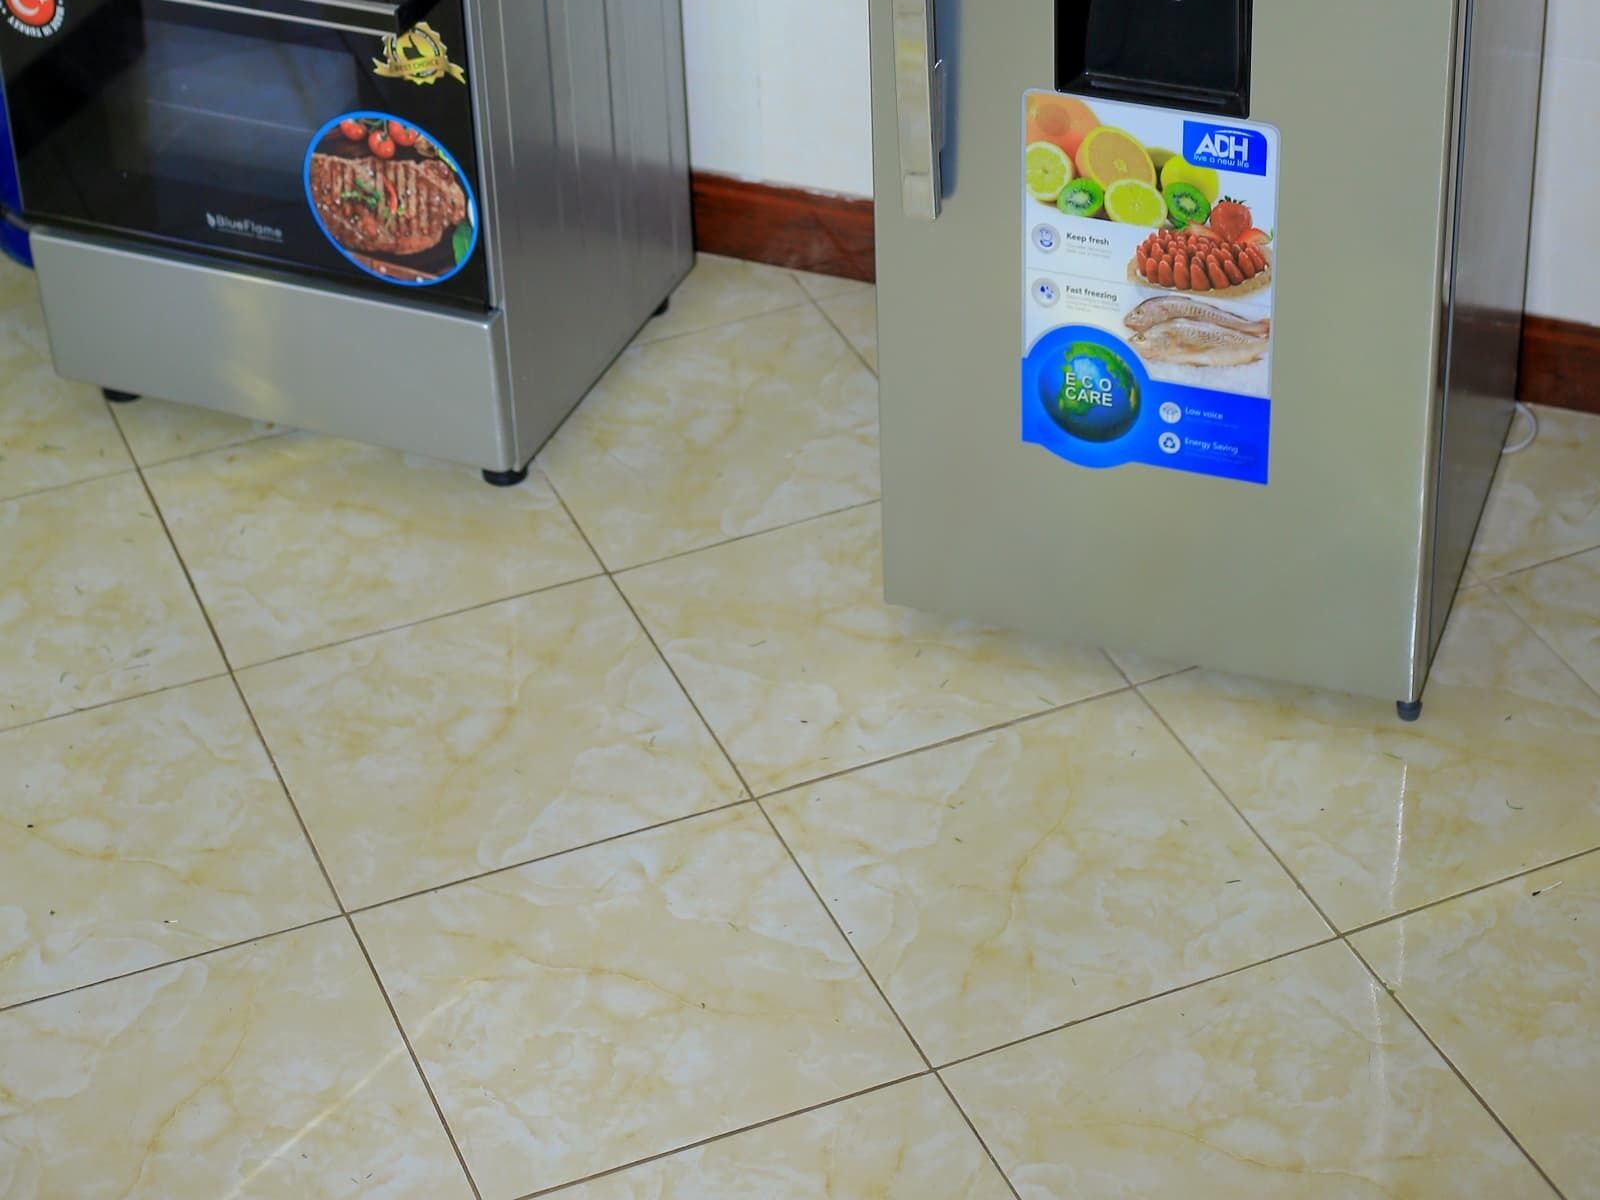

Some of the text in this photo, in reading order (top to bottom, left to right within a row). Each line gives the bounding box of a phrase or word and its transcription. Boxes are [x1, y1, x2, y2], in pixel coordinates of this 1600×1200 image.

[1195, 131, 1249, 161] ADH
[1194, 154, 1207, 162] live
[1217, 158, 1235, 166] new
[1237, 160, 1249, 168] life
[1066, 232, 1109, 246] Keep fresh
[1066, 285, 1117, 302] Fast freezing
[1065, 387, 1113, 407] CARE
[1185, 408, 1201, 416] Low
[1184, 438, 1239, 455] Energy Saving
